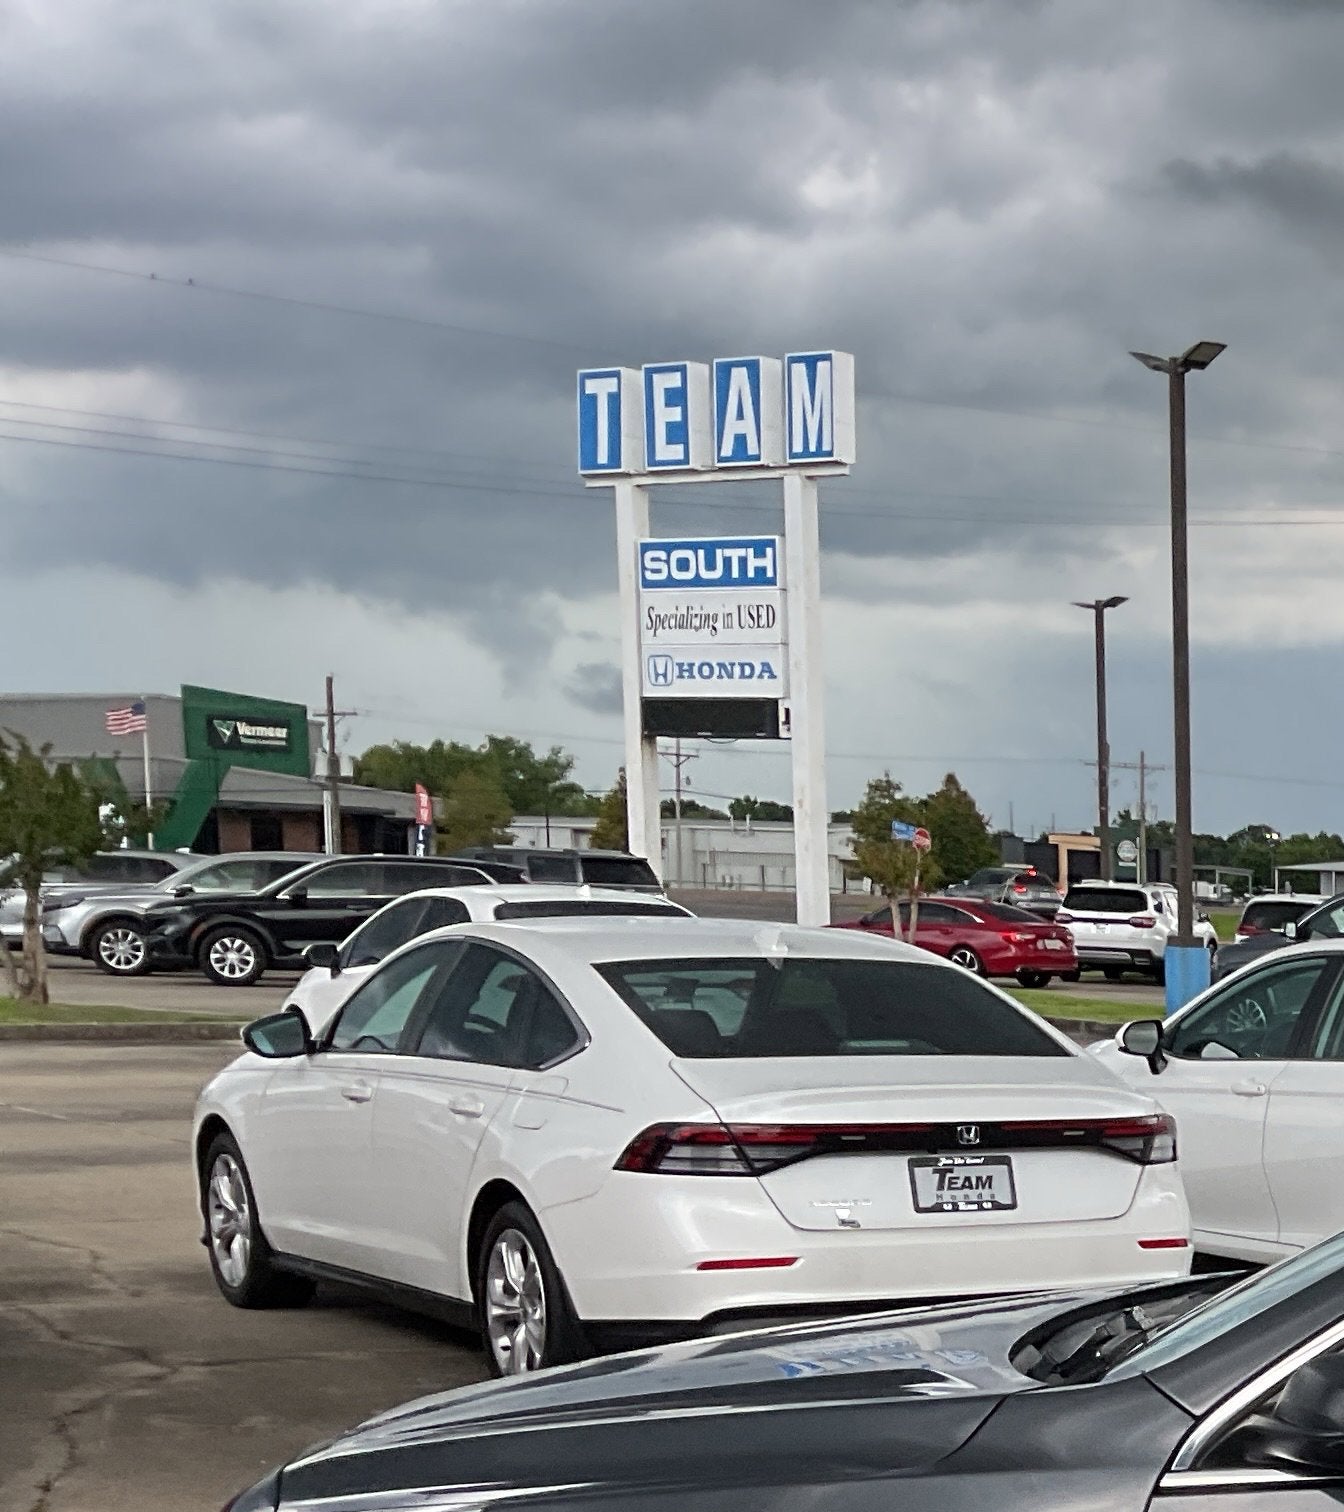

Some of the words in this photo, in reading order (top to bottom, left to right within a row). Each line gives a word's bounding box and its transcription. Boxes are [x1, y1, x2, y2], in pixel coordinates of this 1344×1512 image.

[584, 360, 833, 465] TEAM
[643, 547, 774, 581] SOUTH
[646, 605, 719, 638] Specializing
[722, 603, 735, 629] in
[737, 604, 776, 629] USED
[675, 661, 778, 680] HONDA
